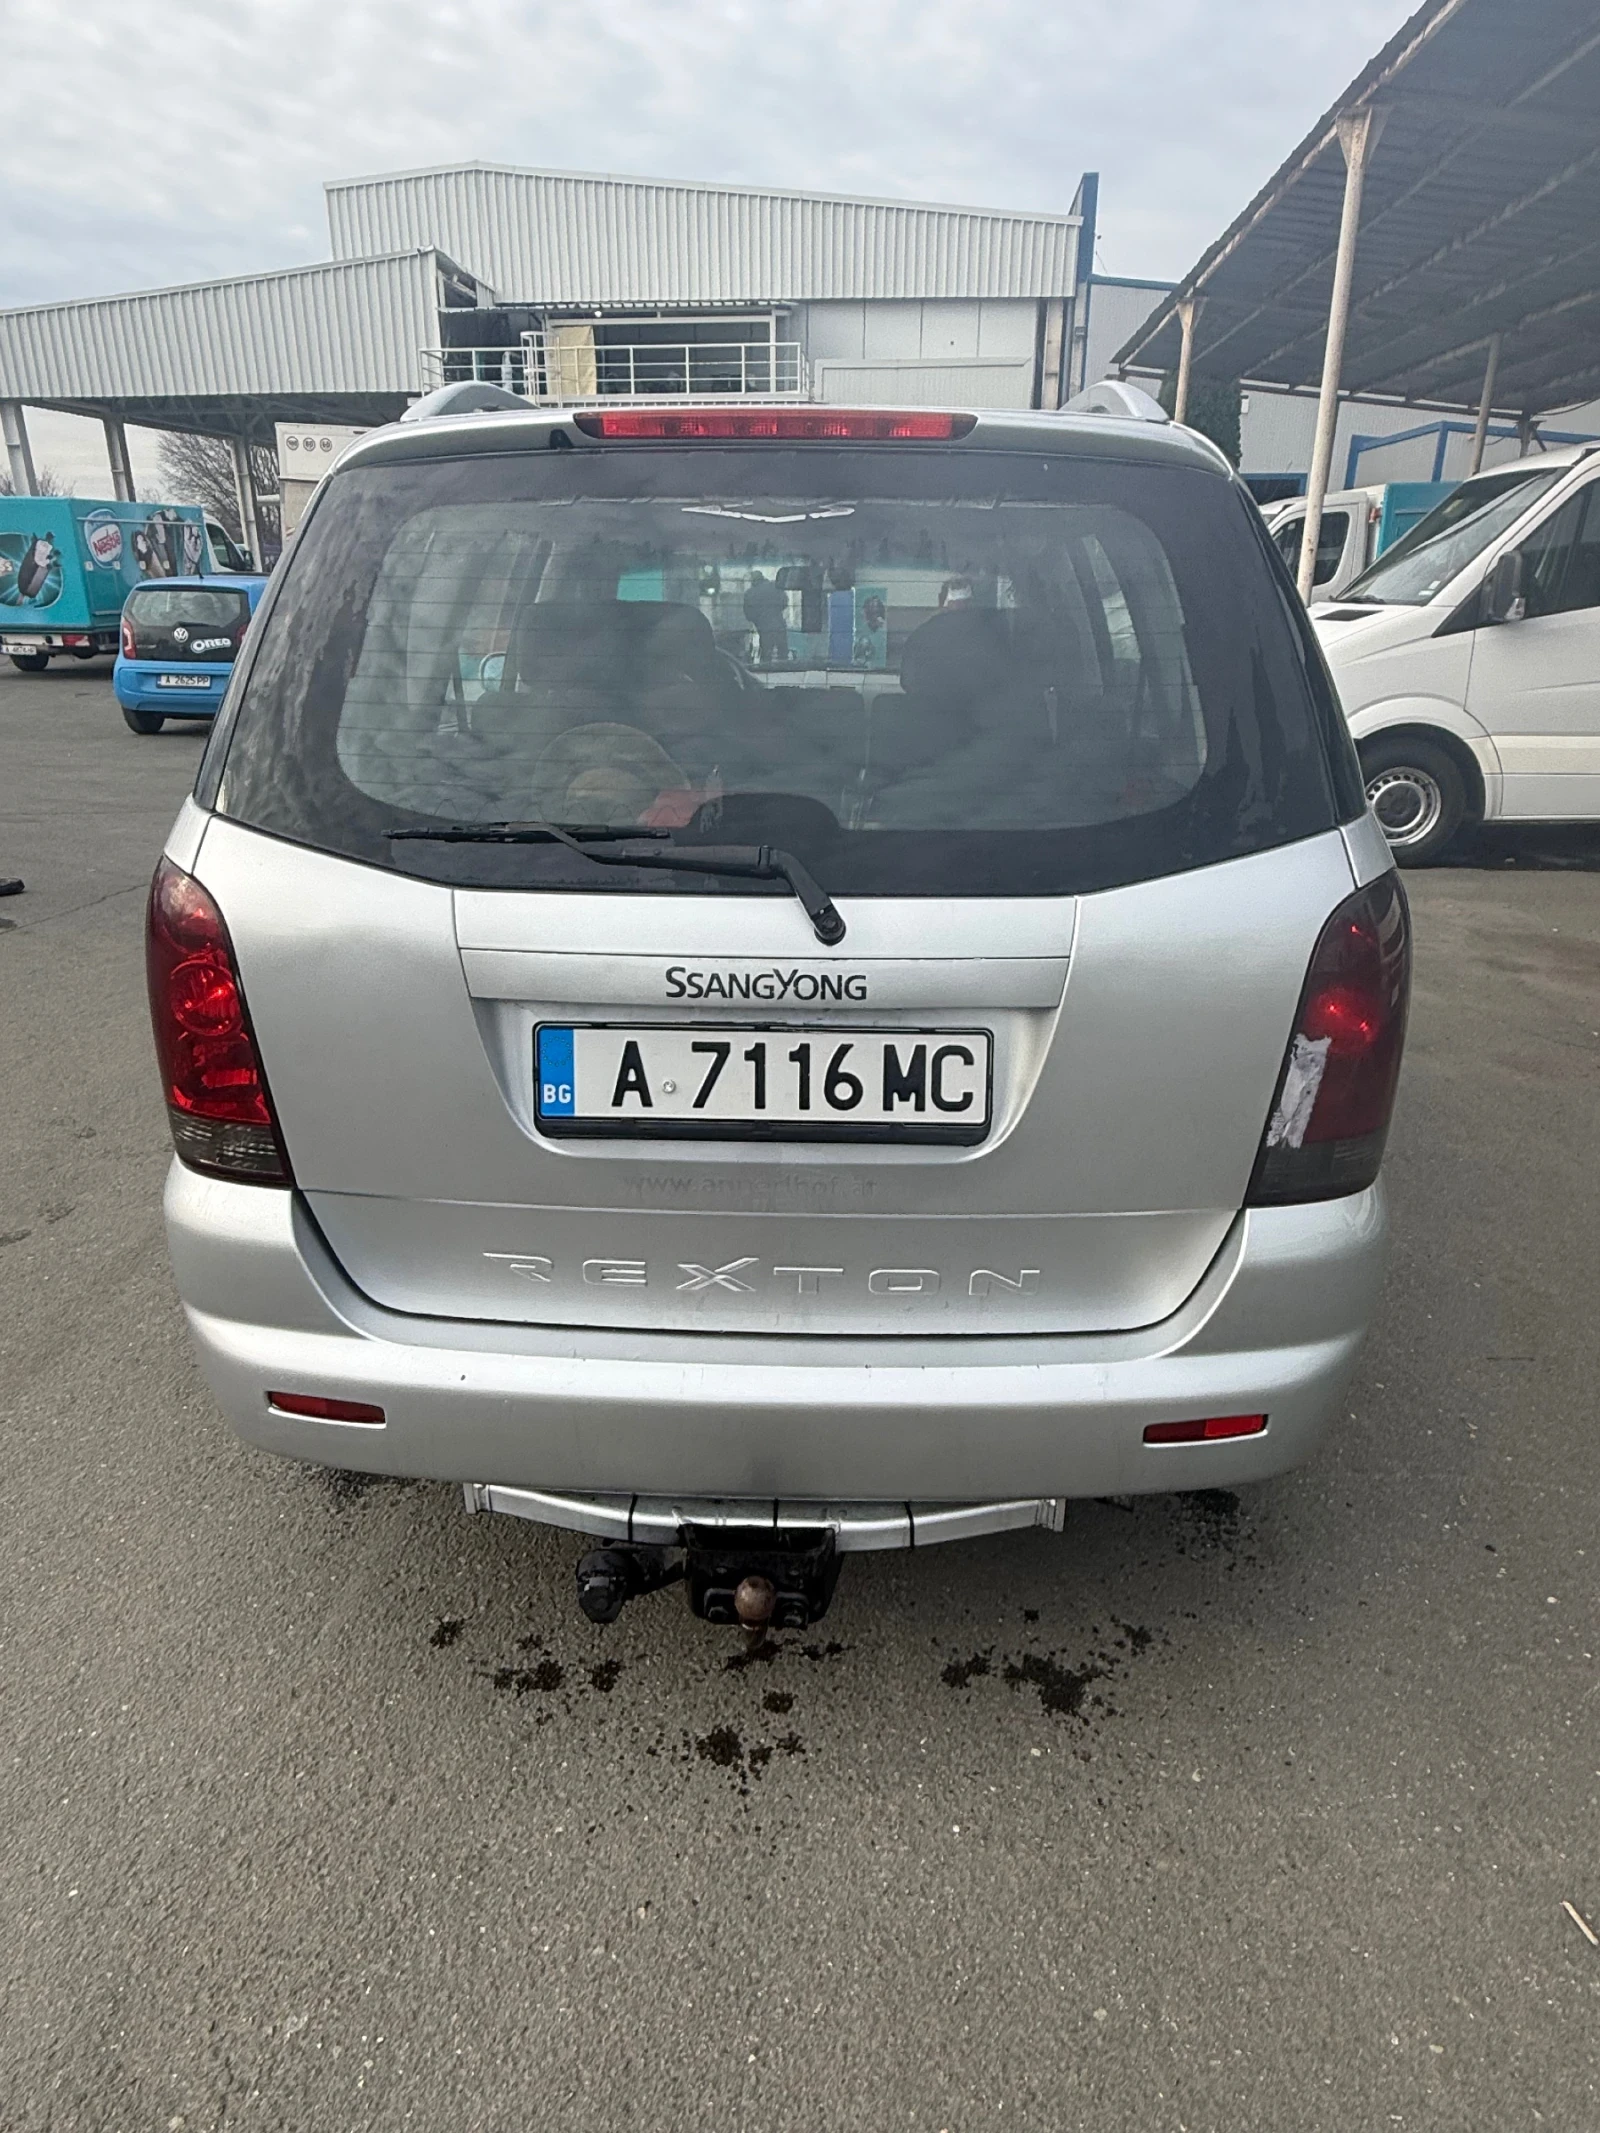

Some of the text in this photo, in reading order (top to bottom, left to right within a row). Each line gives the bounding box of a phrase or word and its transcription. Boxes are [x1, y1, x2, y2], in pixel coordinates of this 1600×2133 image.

[191, 638, 231, 653] OREO
[610, 1040, 976, 1113] A 7116 MC
[542, 1083, 572, 1105] BG
[482, 1251, 1041, 1297] REXTON
